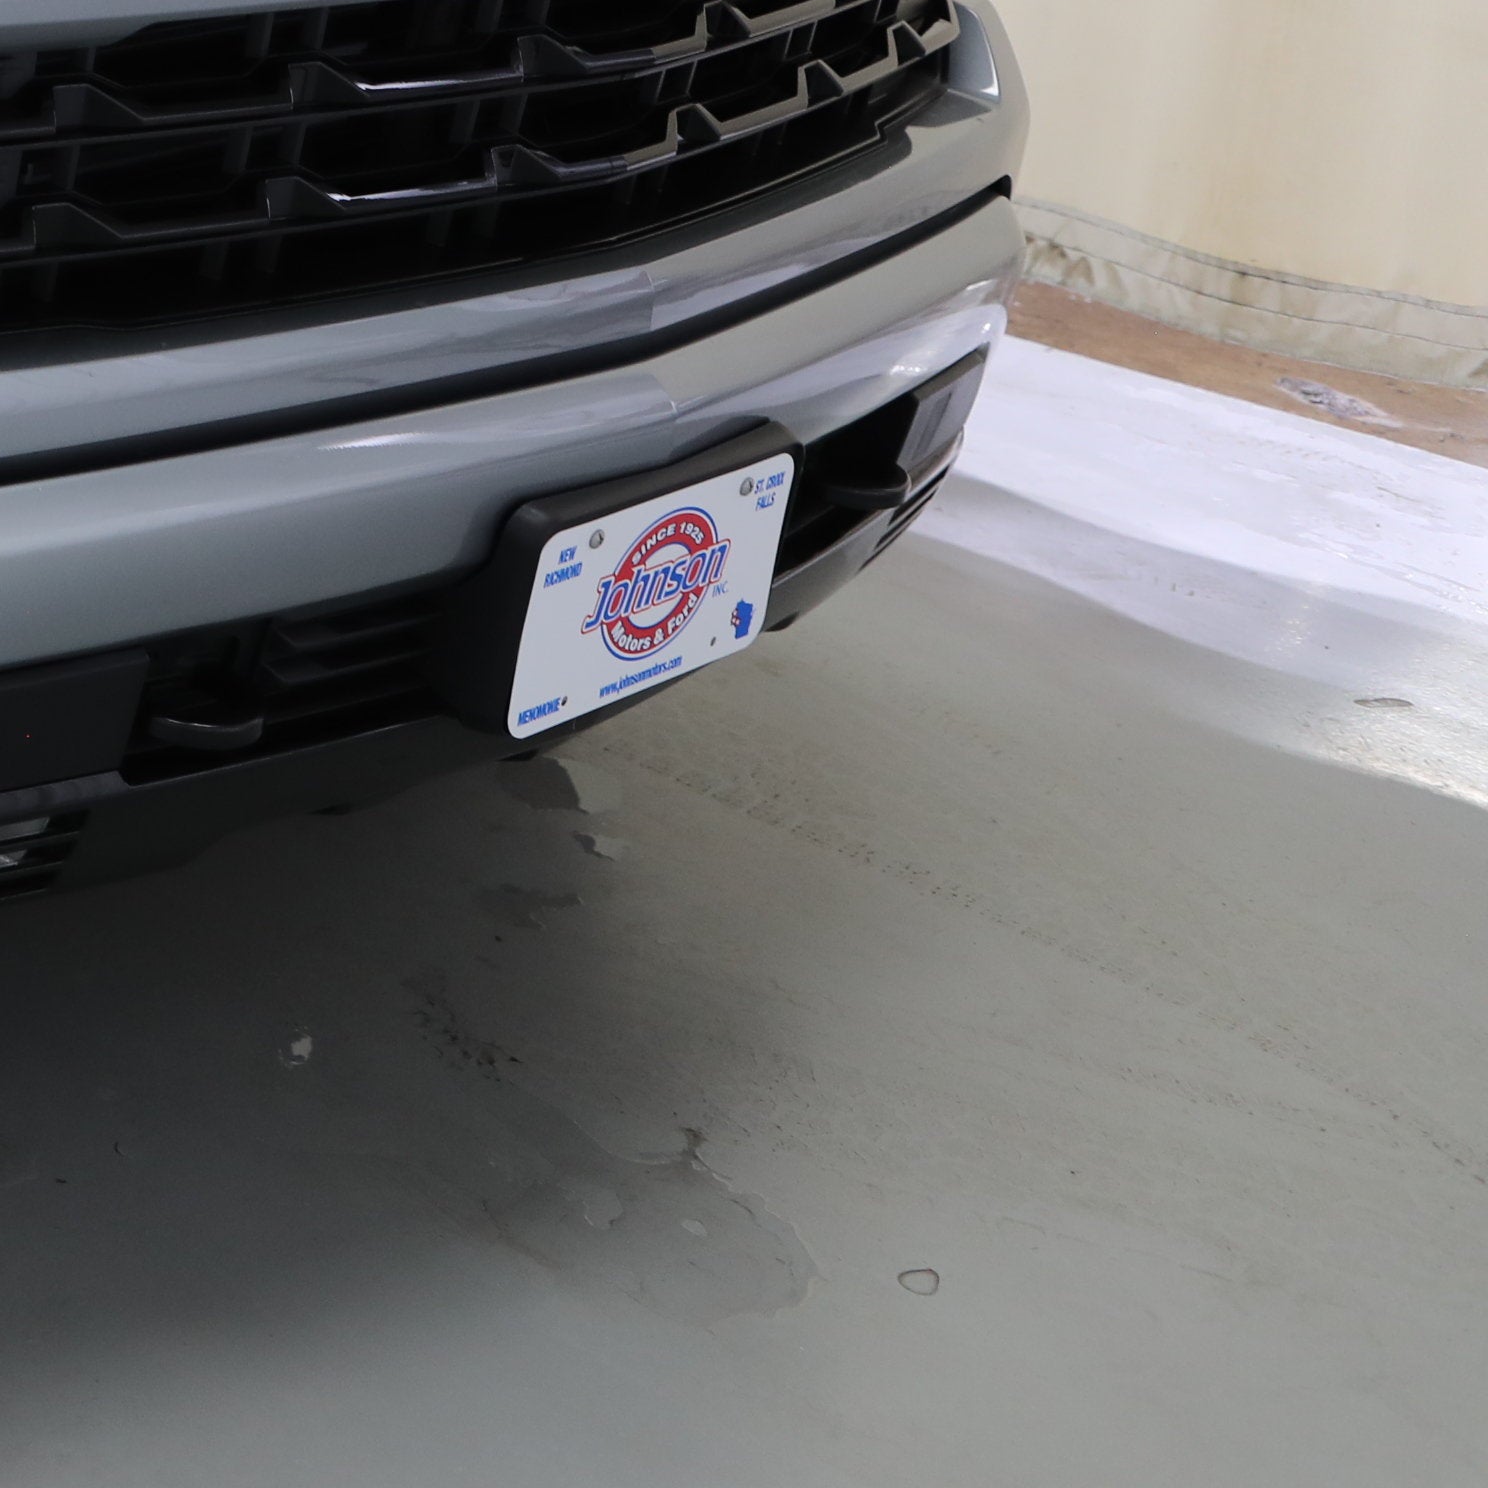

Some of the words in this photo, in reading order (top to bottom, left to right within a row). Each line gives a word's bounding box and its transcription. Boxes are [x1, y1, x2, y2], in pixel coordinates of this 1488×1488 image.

[755, 492, 776, 511] FALLS
[558, 545, 577, 564] NEW
[631, 523, 676, 565] SINCE
[680, 521, 705, 545] 1925
[582, 540, 730, 633] Johnson
[610, 620, 652, 651] Motors
[653, 628, 665, 645] &
[667, 593, 699, 636] Ford
